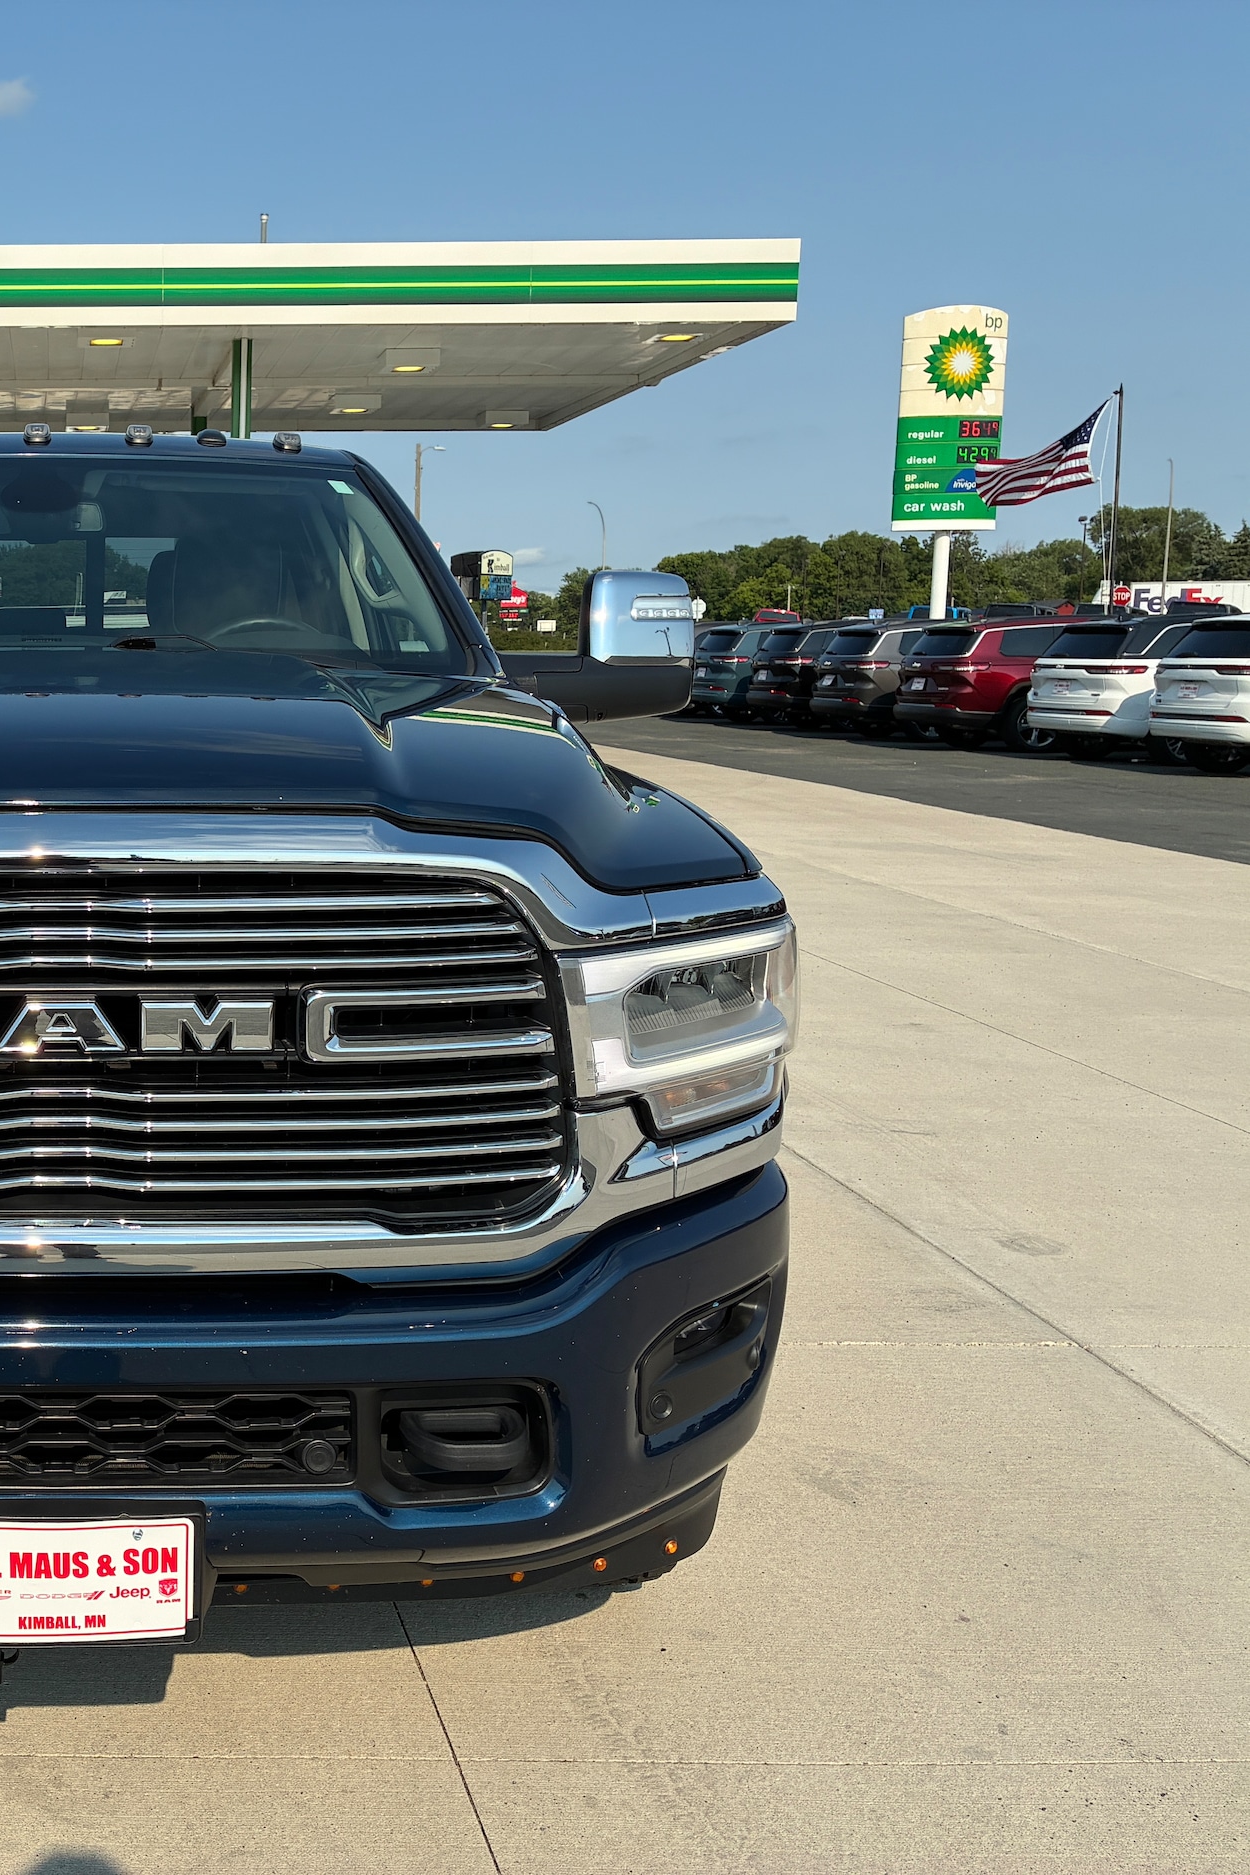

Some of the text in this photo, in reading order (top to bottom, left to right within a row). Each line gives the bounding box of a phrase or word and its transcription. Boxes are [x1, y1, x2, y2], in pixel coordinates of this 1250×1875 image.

[985, 313, 1003, 332] bp
[907, 429, 944, 440] regular
[906, 455, 937, 465] diesel
[904, 473, 918, 482] BP
[904, 481, 940, 491] gasoline
[952, 480, 976, 491] Invigo
[903, 500, 965, 512] car wash
[1113, 592, 1130, 600] STOP
[9, 1551, 89, 1579] MAUS
[96, 1554, 117, 1577] &
[123, 1547, 178, 1575] SON
[109, 1586, 150, 1600] Jeep
[18, 1614, 107, 1630] KIMBALL, MN
